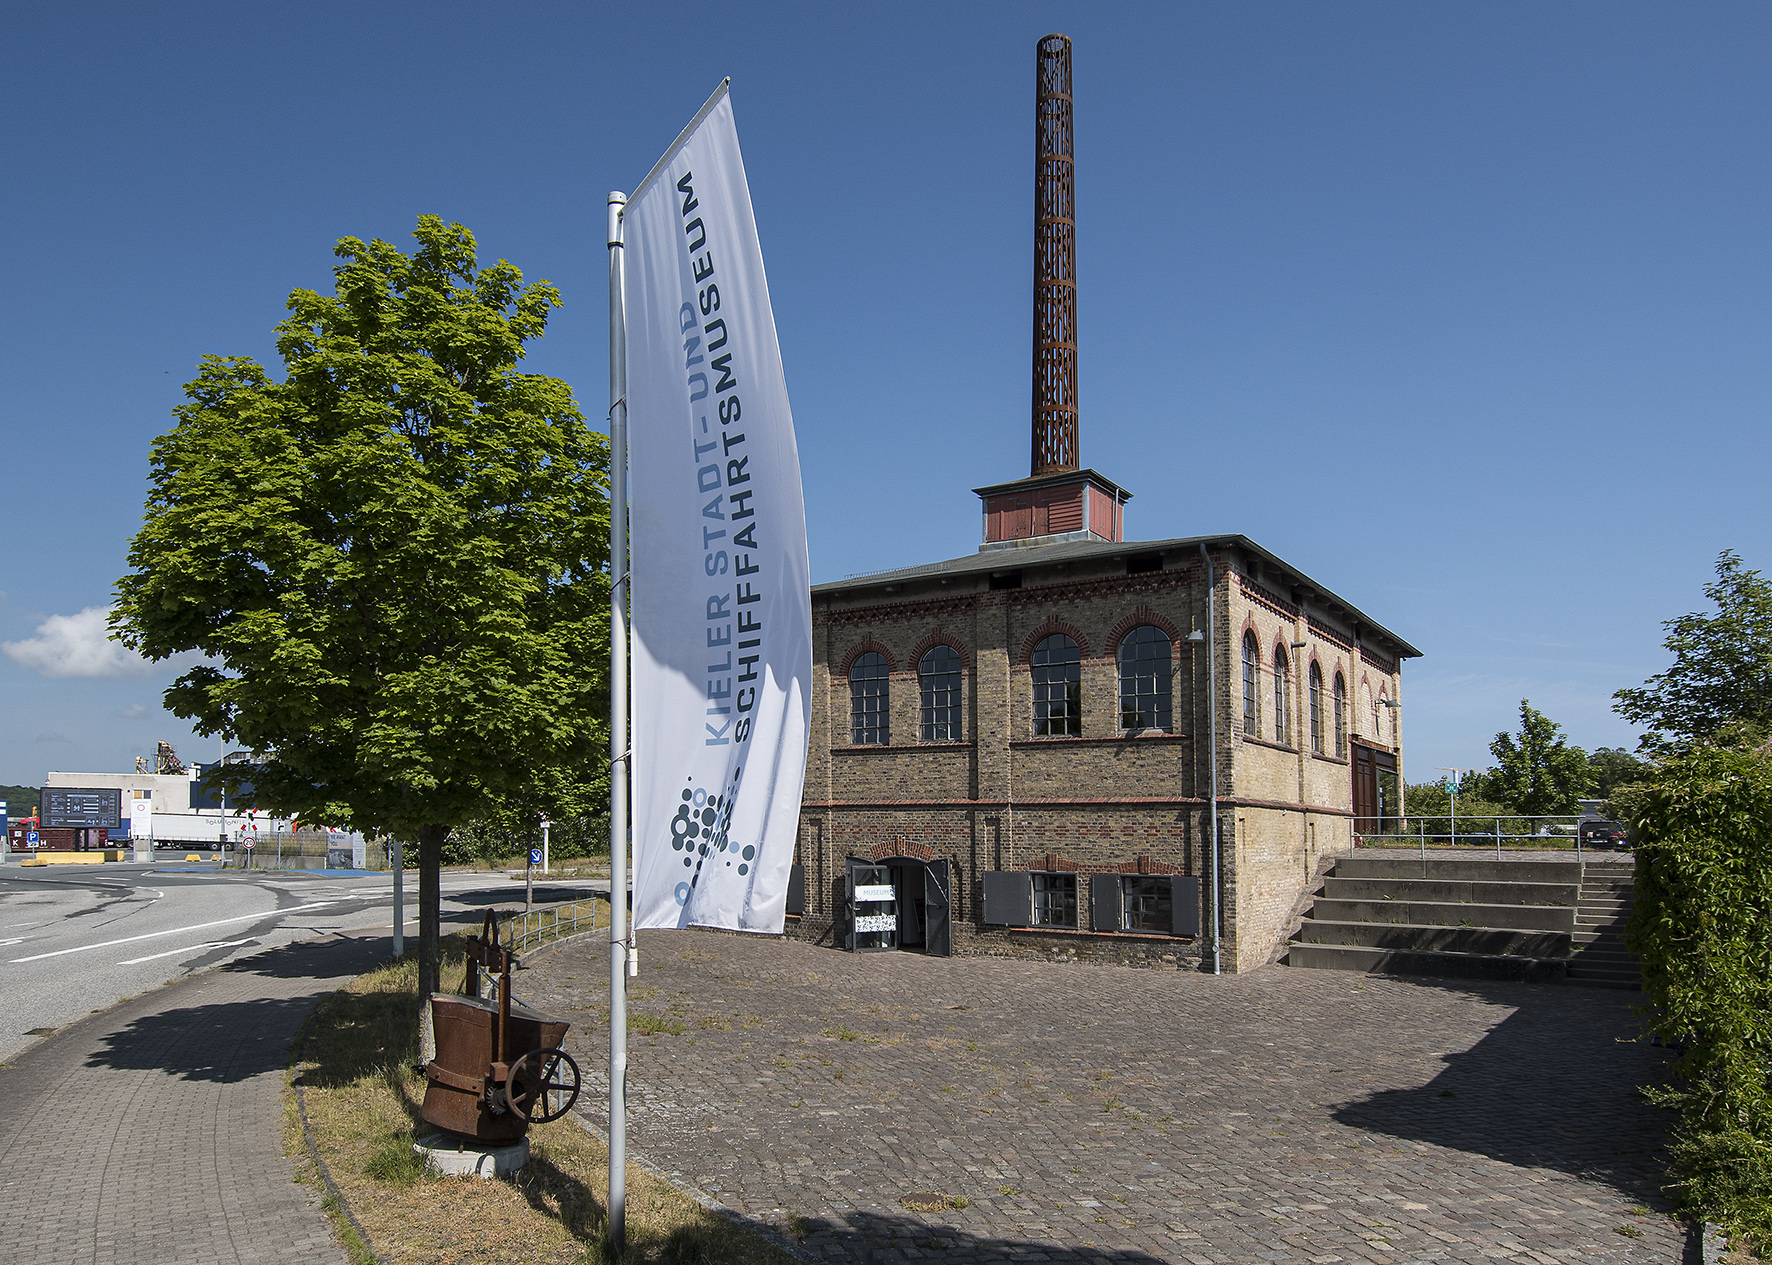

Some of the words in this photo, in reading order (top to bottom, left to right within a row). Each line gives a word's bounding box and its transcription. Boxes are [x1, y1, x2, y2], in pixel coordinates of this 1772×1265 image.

[679, 300, 709, 404] UND
[676, 170, 762, 744] SCHIFFFAHRTSMUSEUM
[693, 415, 729, 577] STADT-
[705, 592, 732, 747] KIELER
